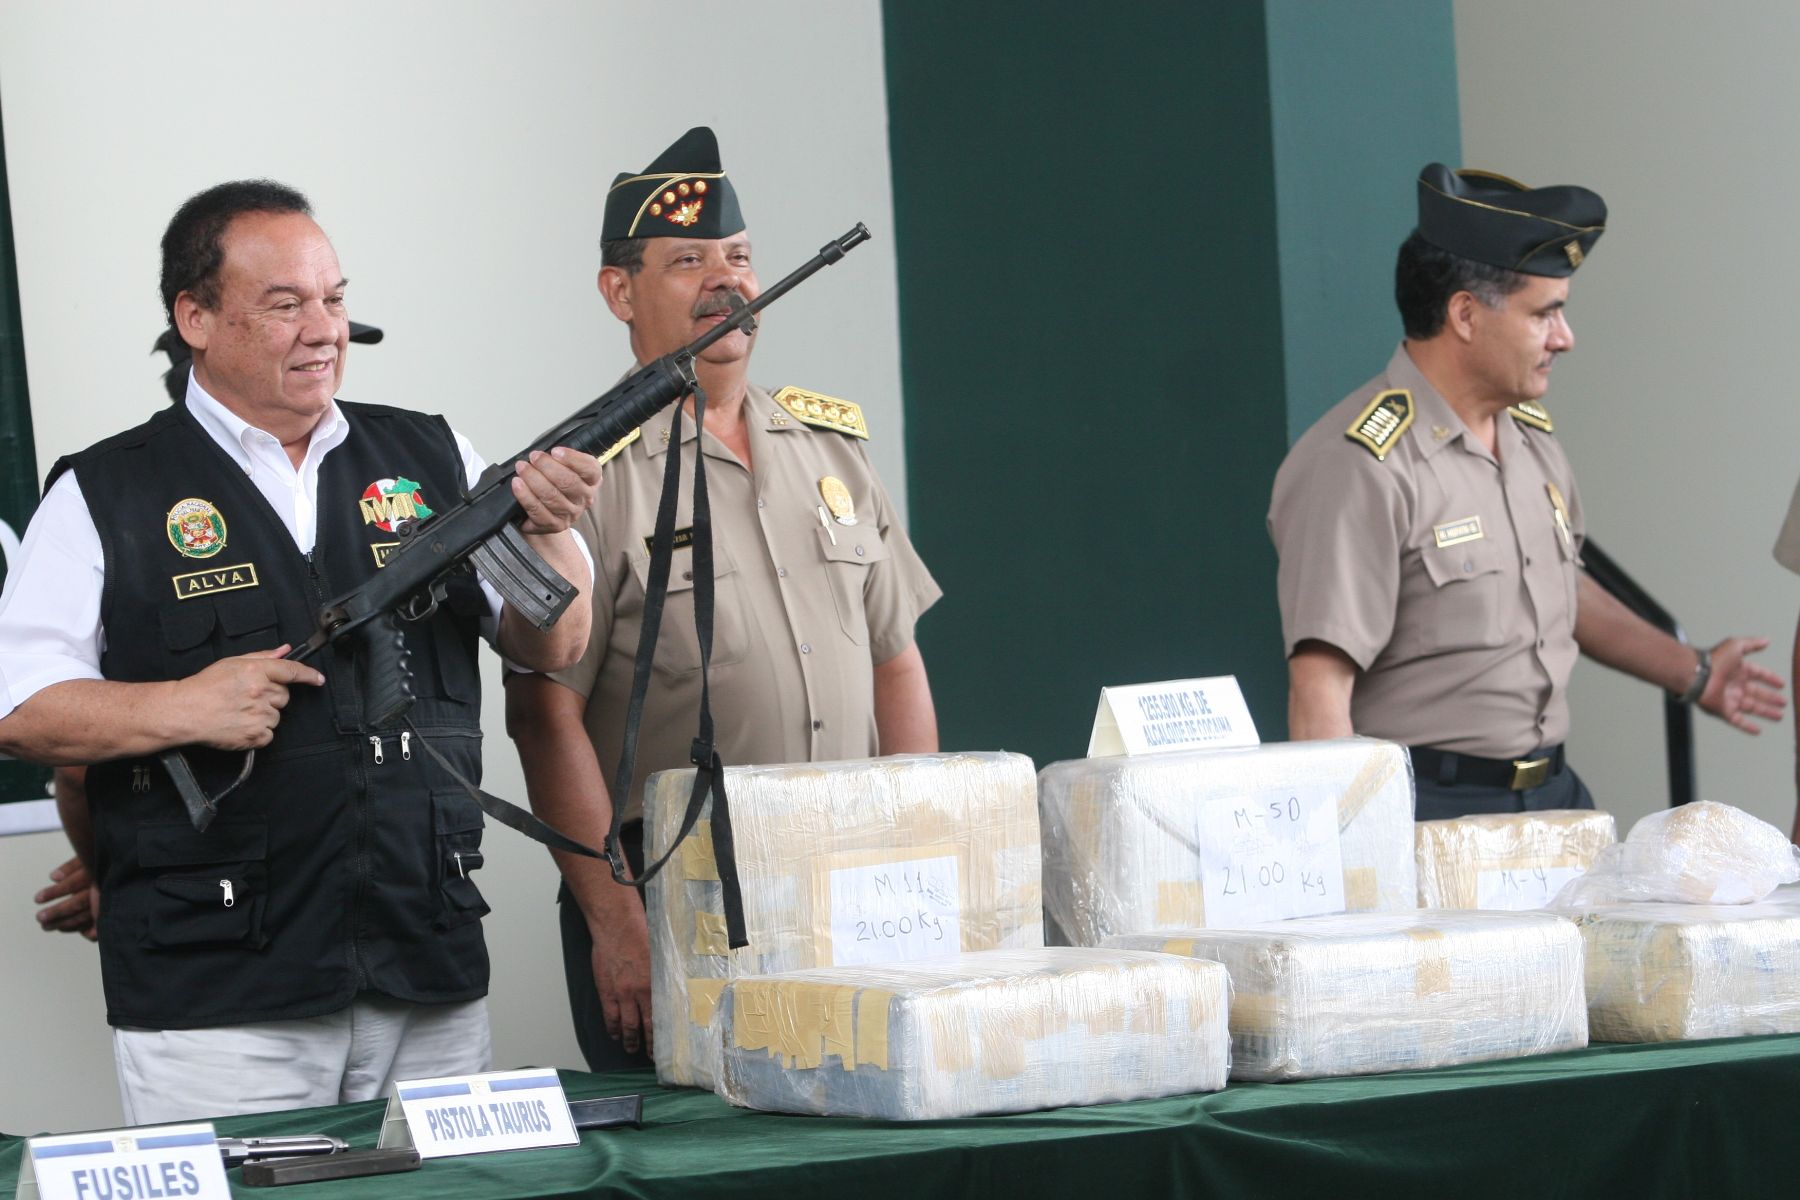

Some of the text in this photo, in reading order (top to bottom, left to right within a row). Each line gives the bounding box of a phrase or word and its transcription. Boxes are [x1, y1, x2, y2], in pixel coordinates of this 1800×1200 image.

[188, 571, 244, 591] ALVA
[1193, 690, 1213, 714] DE
[1184, 719, 1201, 742] DE
[1234, 797, 1300, 828] M-50
[1223, 861, 1285, 896] 21.00
[856, 916, 912, 941] 21.00
[425, 1099, 552, 1141] PISTOLA TAURUS
[72, 1160, 200, 1200] FUSILES
